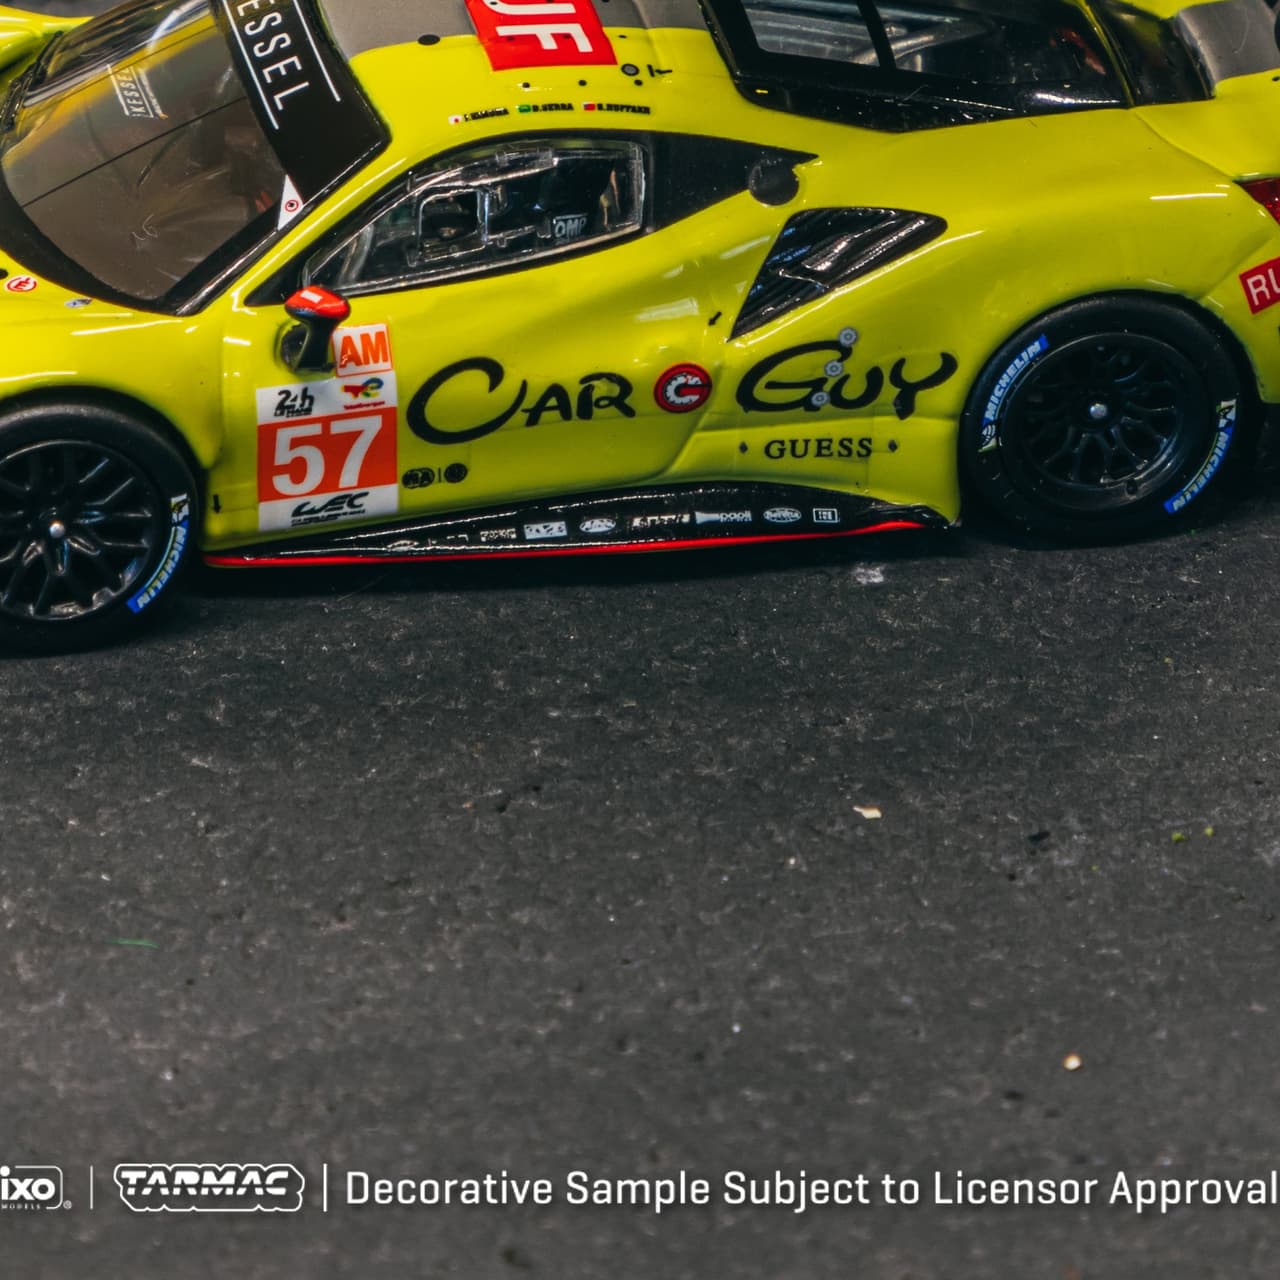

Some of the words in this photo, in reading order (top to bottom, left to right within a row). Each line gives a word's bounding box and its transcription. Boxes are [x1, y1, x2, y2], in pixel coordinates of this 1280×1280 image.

[339, 330, 389, 369] AM
[983, 340, 1041, 422] MICHELIN
[271, 417, 384, 497] 57
[763, 437, 873, 460] GUESS
[1172, 431, 1230, 512] MICHELIN
[290, 491, 370, 518] WEC
[136, 525, 188, 609] MICHELIN
